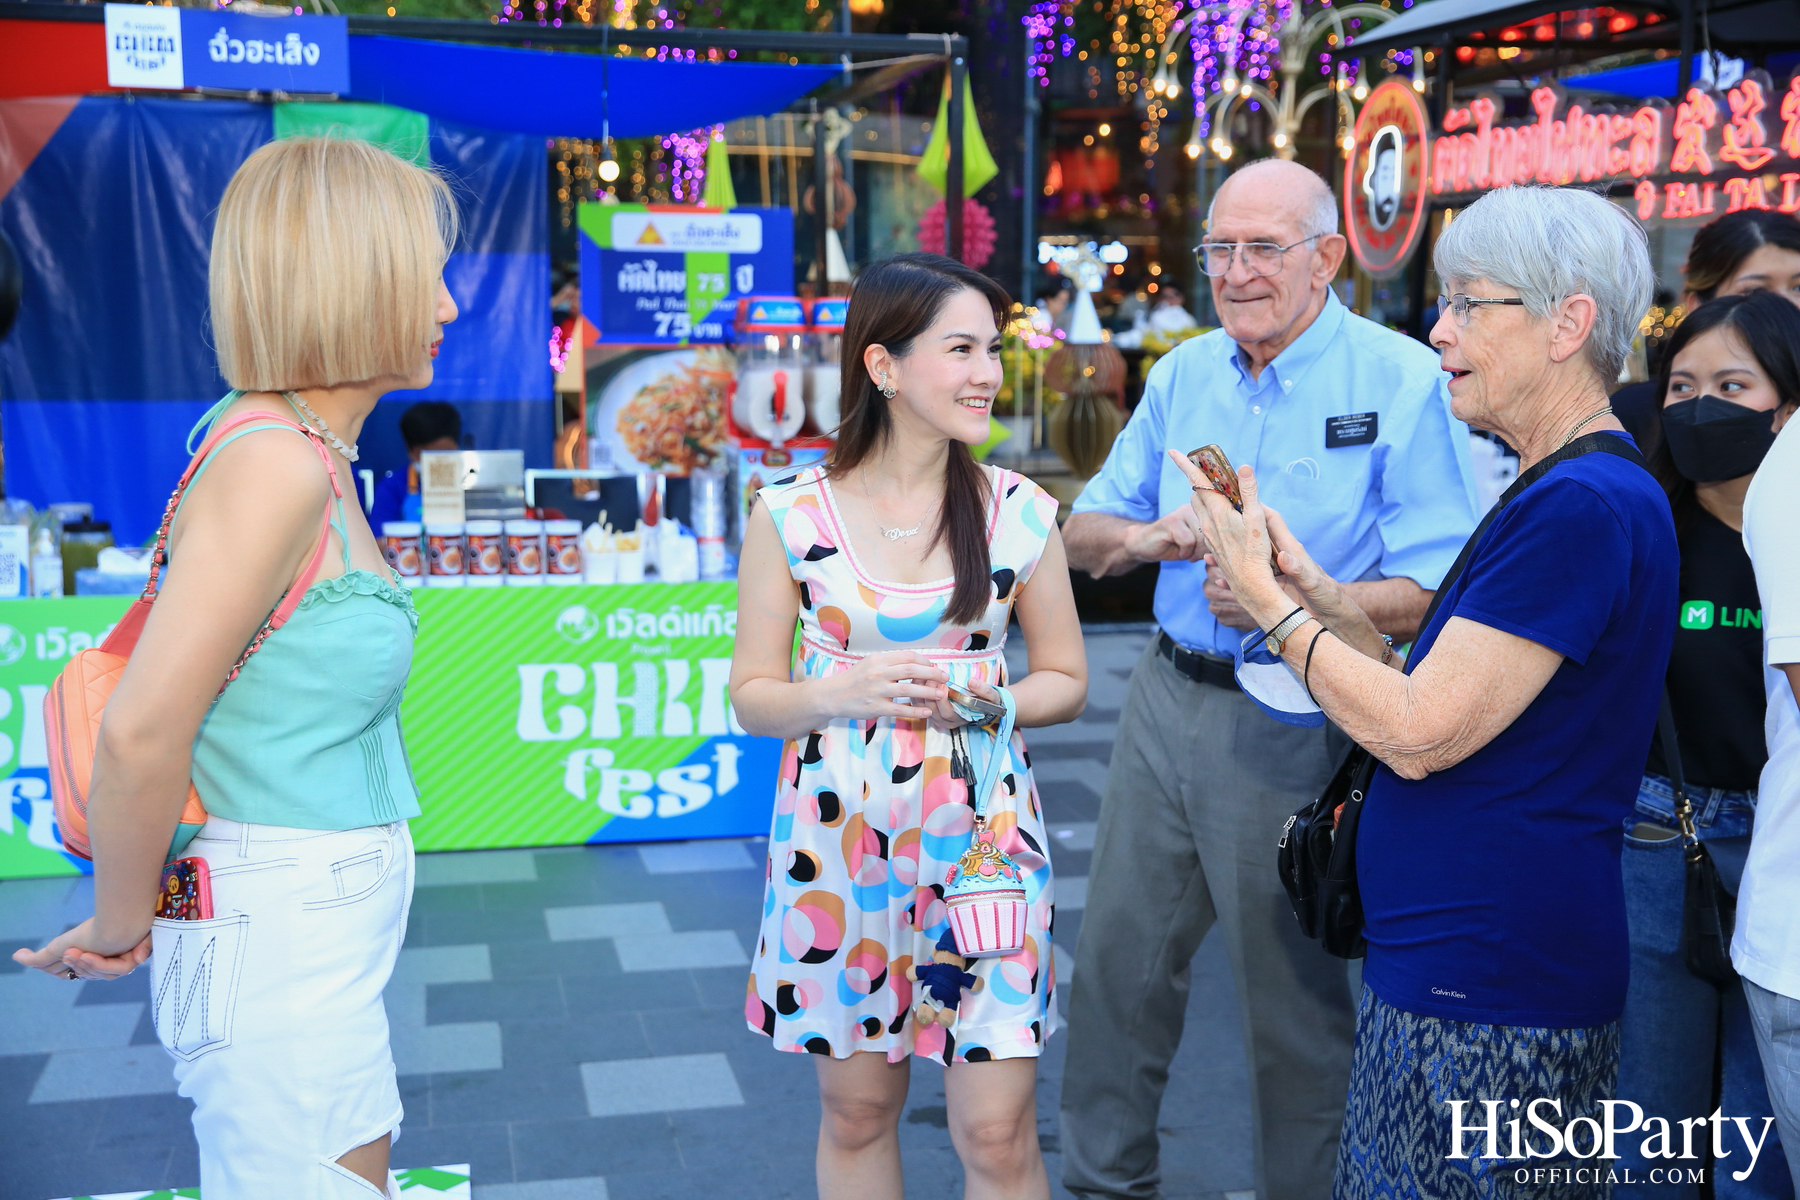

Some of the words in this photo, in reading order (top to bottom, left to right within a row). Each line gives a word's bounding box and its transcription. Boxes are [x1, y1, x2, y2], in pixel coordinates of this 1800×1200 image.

[209, 26, 320, 66] ฉั่วฮะเส็ง
[653, 311, 692, 338] 75
[1720, 606, 1762, 629] LIN
[560, 743, 744, 819] fest
[1431, 986, 1450, 997] Calvin
[1451, 990, 1466, 999] Klein
